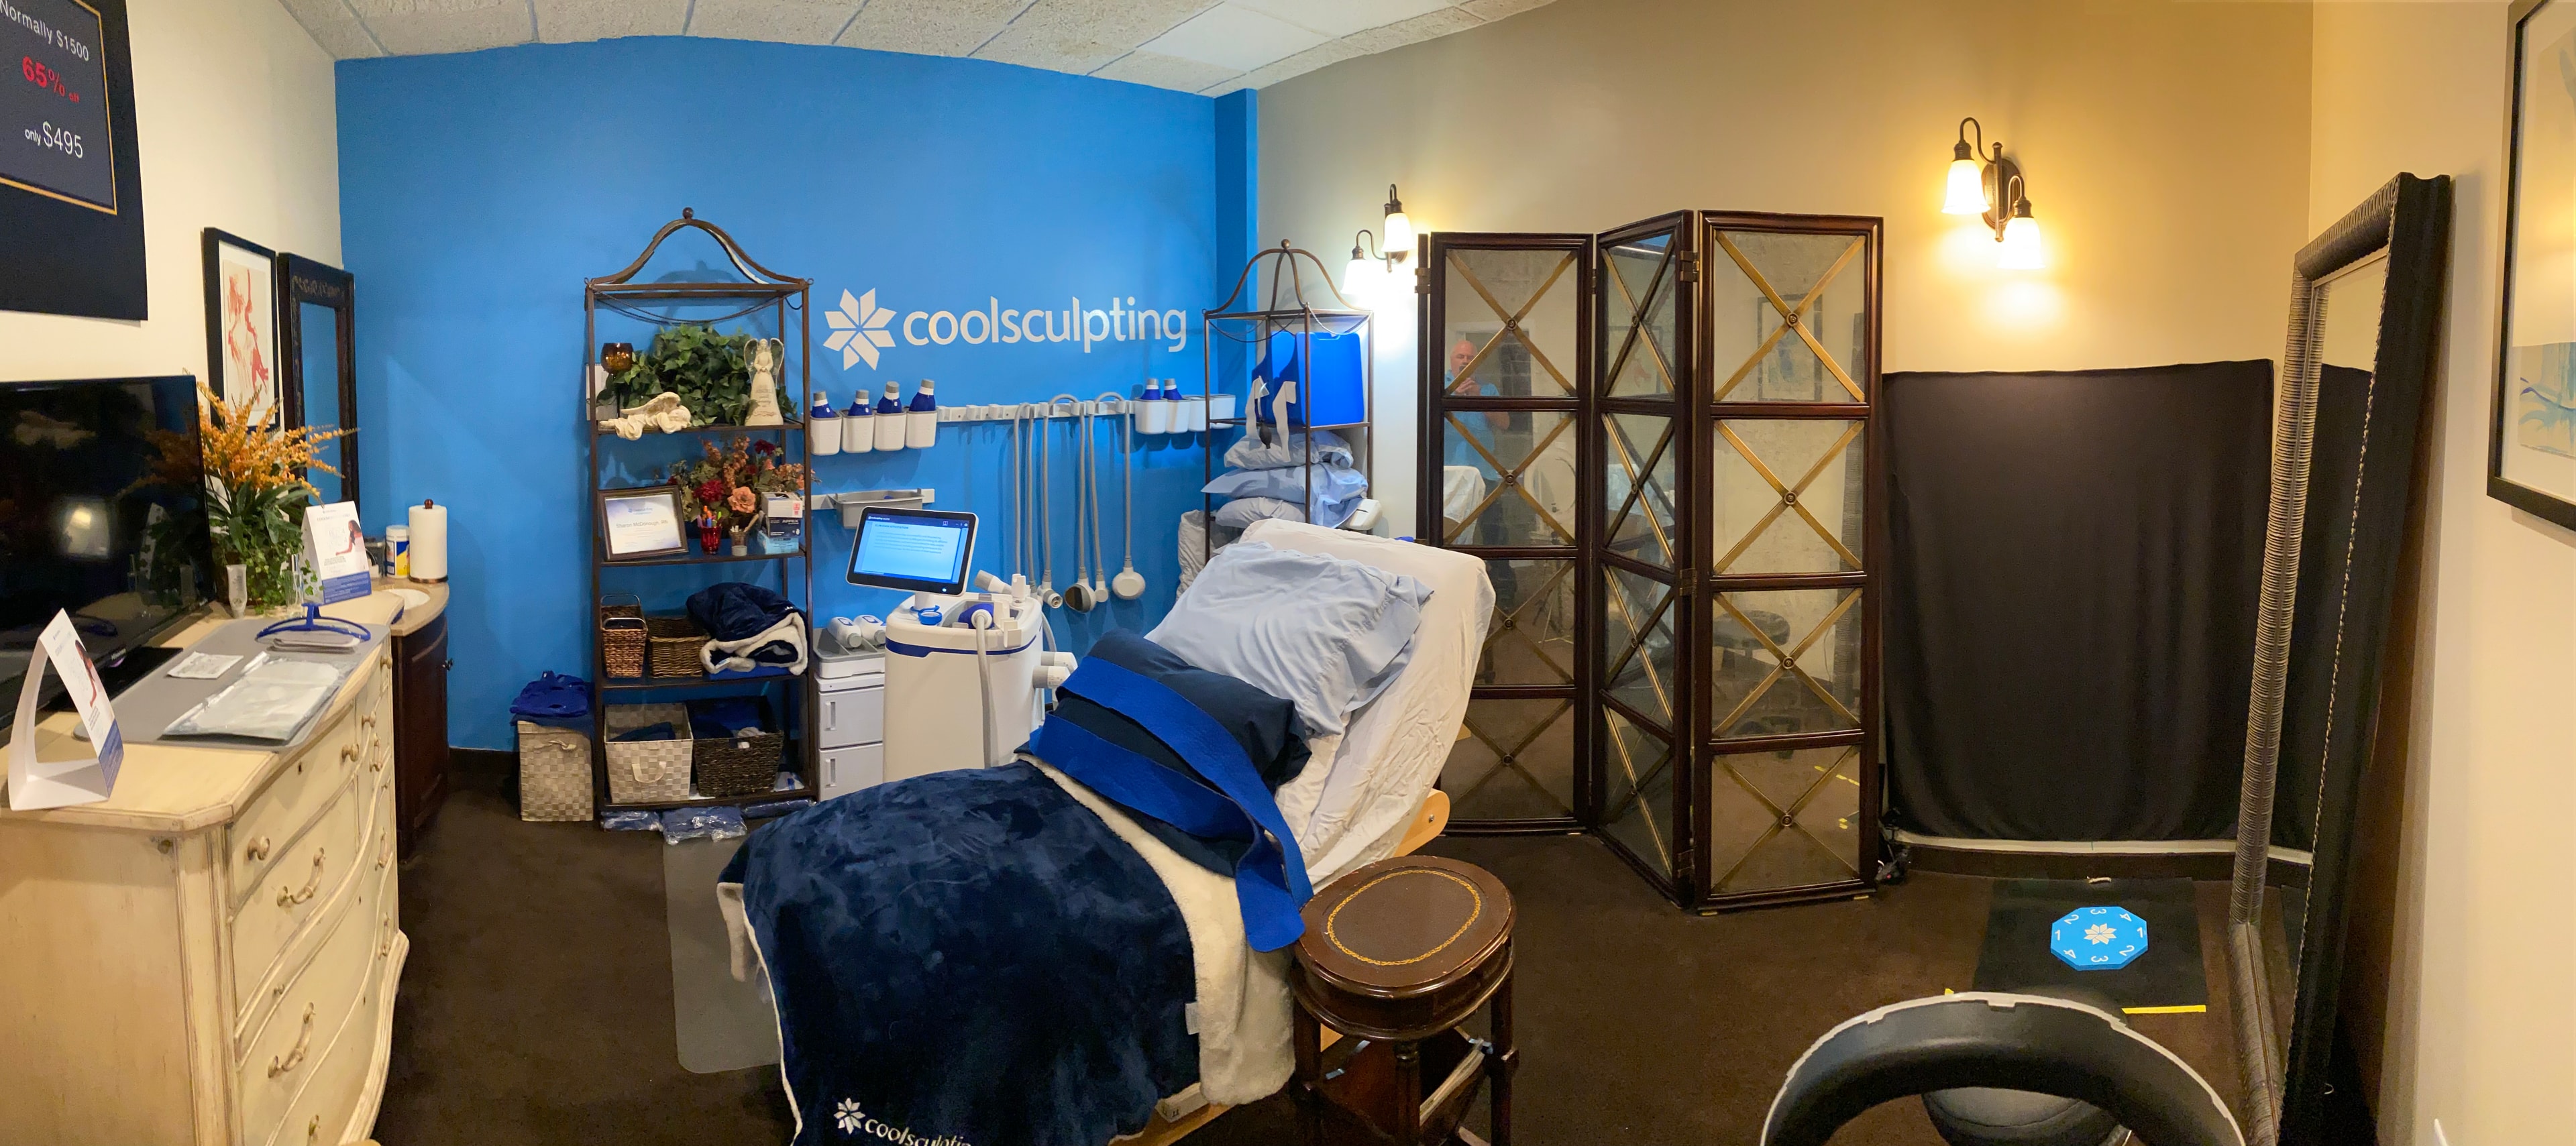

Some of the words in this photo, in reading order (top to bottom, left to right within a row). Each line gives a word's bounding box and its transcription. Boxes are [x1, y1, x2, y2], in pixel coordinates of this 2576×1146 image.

[0, 0, 52, 45] Normally
[56, 30, 89, 62] $1500
[22, 56, 65, 97] 65%
[25, 129, 41, 146] only
[42, 121, 83, 159] $495
[903, 296, 1187, 353] coolsculpting
[2063, 914, 2080, 925] 2
[2119, 913, 2132, 922] 4
[2055, 929, 2061, 941] 1
[2137, 927, 2143, 938] 1
[2063, 949, 2076, 959] 4
[2118, 945, 2135, 956] 2
